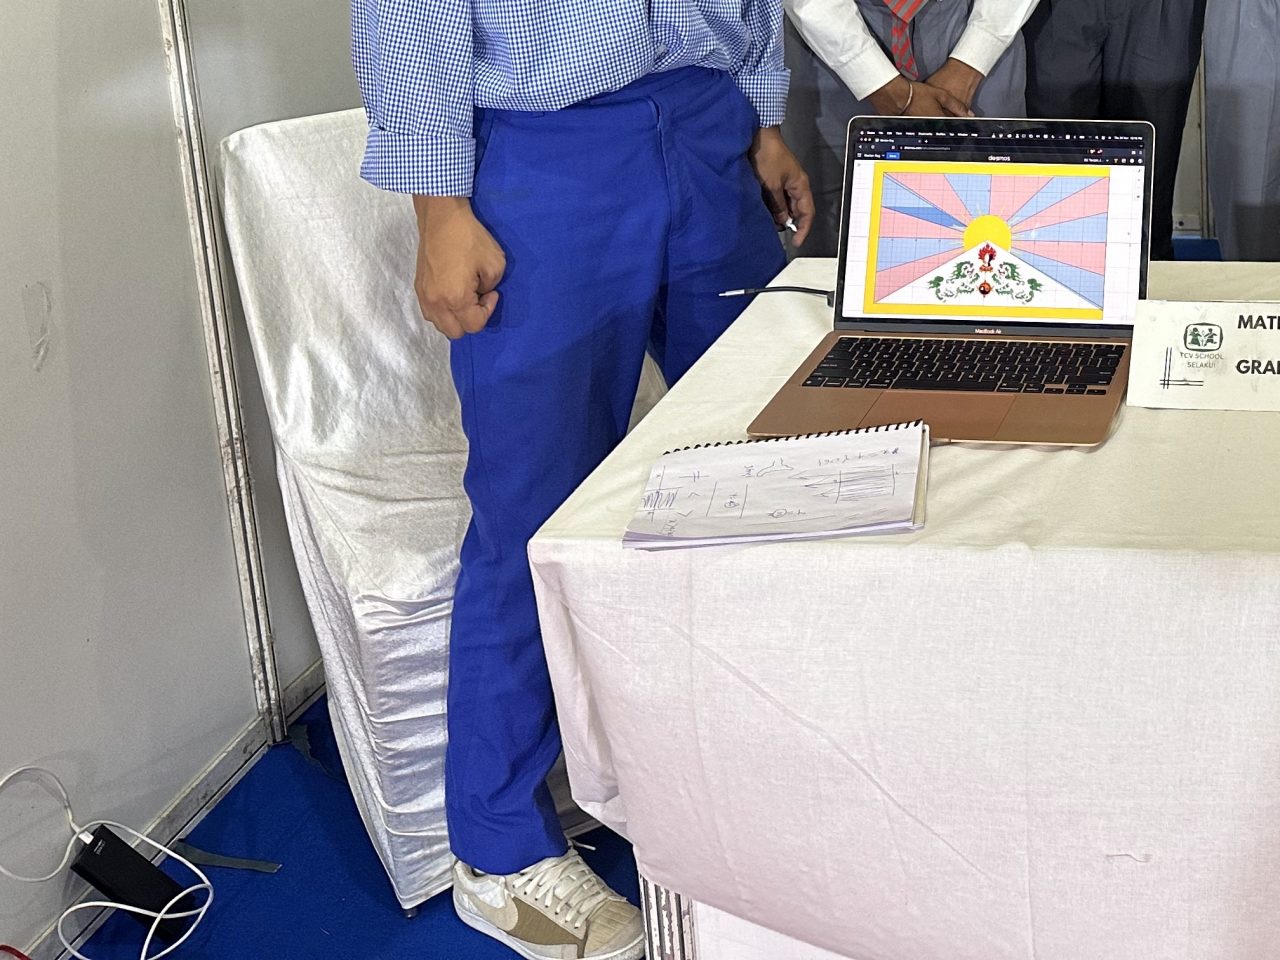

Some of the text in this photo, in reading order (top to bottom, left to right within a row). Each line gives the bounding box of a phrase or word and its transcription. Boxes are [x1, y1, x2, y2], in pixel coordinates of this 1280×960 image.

[1180, 351, 1225, 360] TCV SCHOOL
[1187, 361, 1216, 369] SELAKUI
